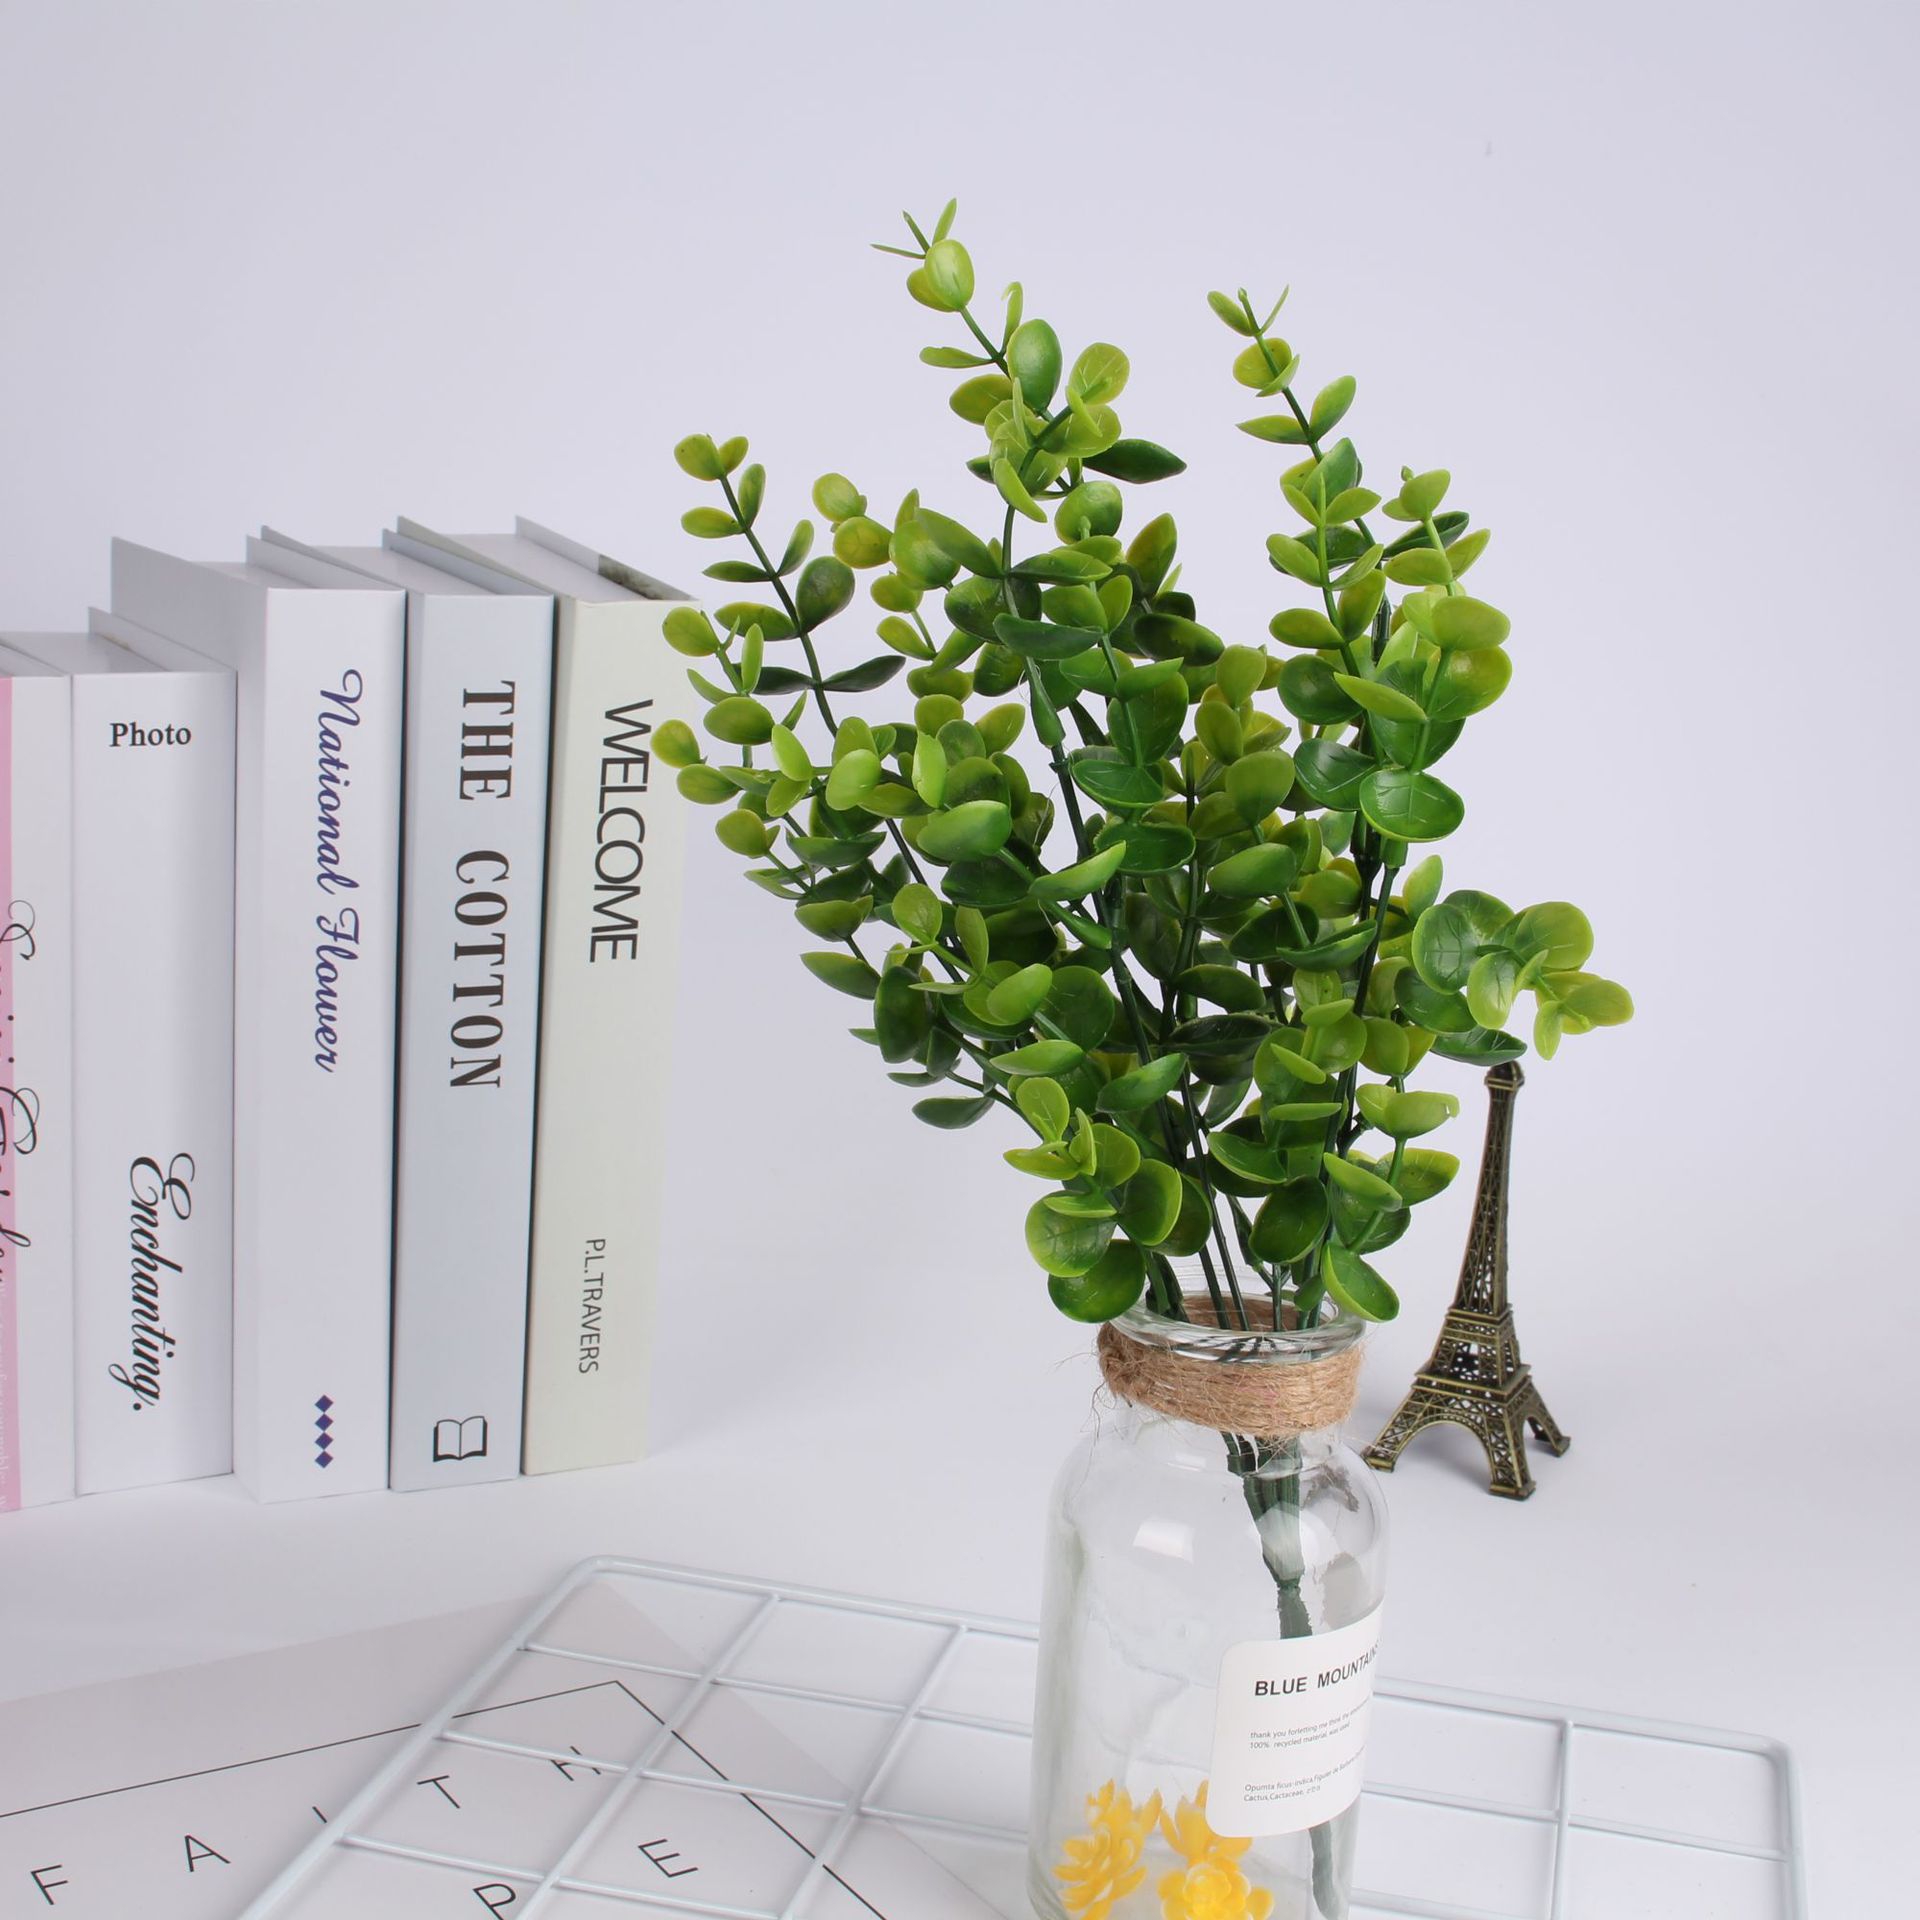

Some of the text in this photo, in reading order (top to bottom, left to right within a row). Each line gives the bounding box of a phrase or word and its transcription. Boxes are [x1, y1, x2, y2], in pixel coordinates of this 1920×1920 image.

[108, 721, 192, 748] Photo
[313, 668, 364, 1073] National Flower
[449, 679, 516, 1089] THE COTTON
[589, 698, 654, 964] WELCOME
[107, 1152, 196, 1412] Enchanting.
[578, 1238, 607, 1374] P.L.TRAVERS
[1250, 1731, 1271, 1739] thank
[1273, 1729, 1286, 1739] you
[1250, 1741, 1270, 1749] 100%
[1273, 1737, 1302, 1748] recycled
[1254, 1676, 1308, 1697] BLUE
